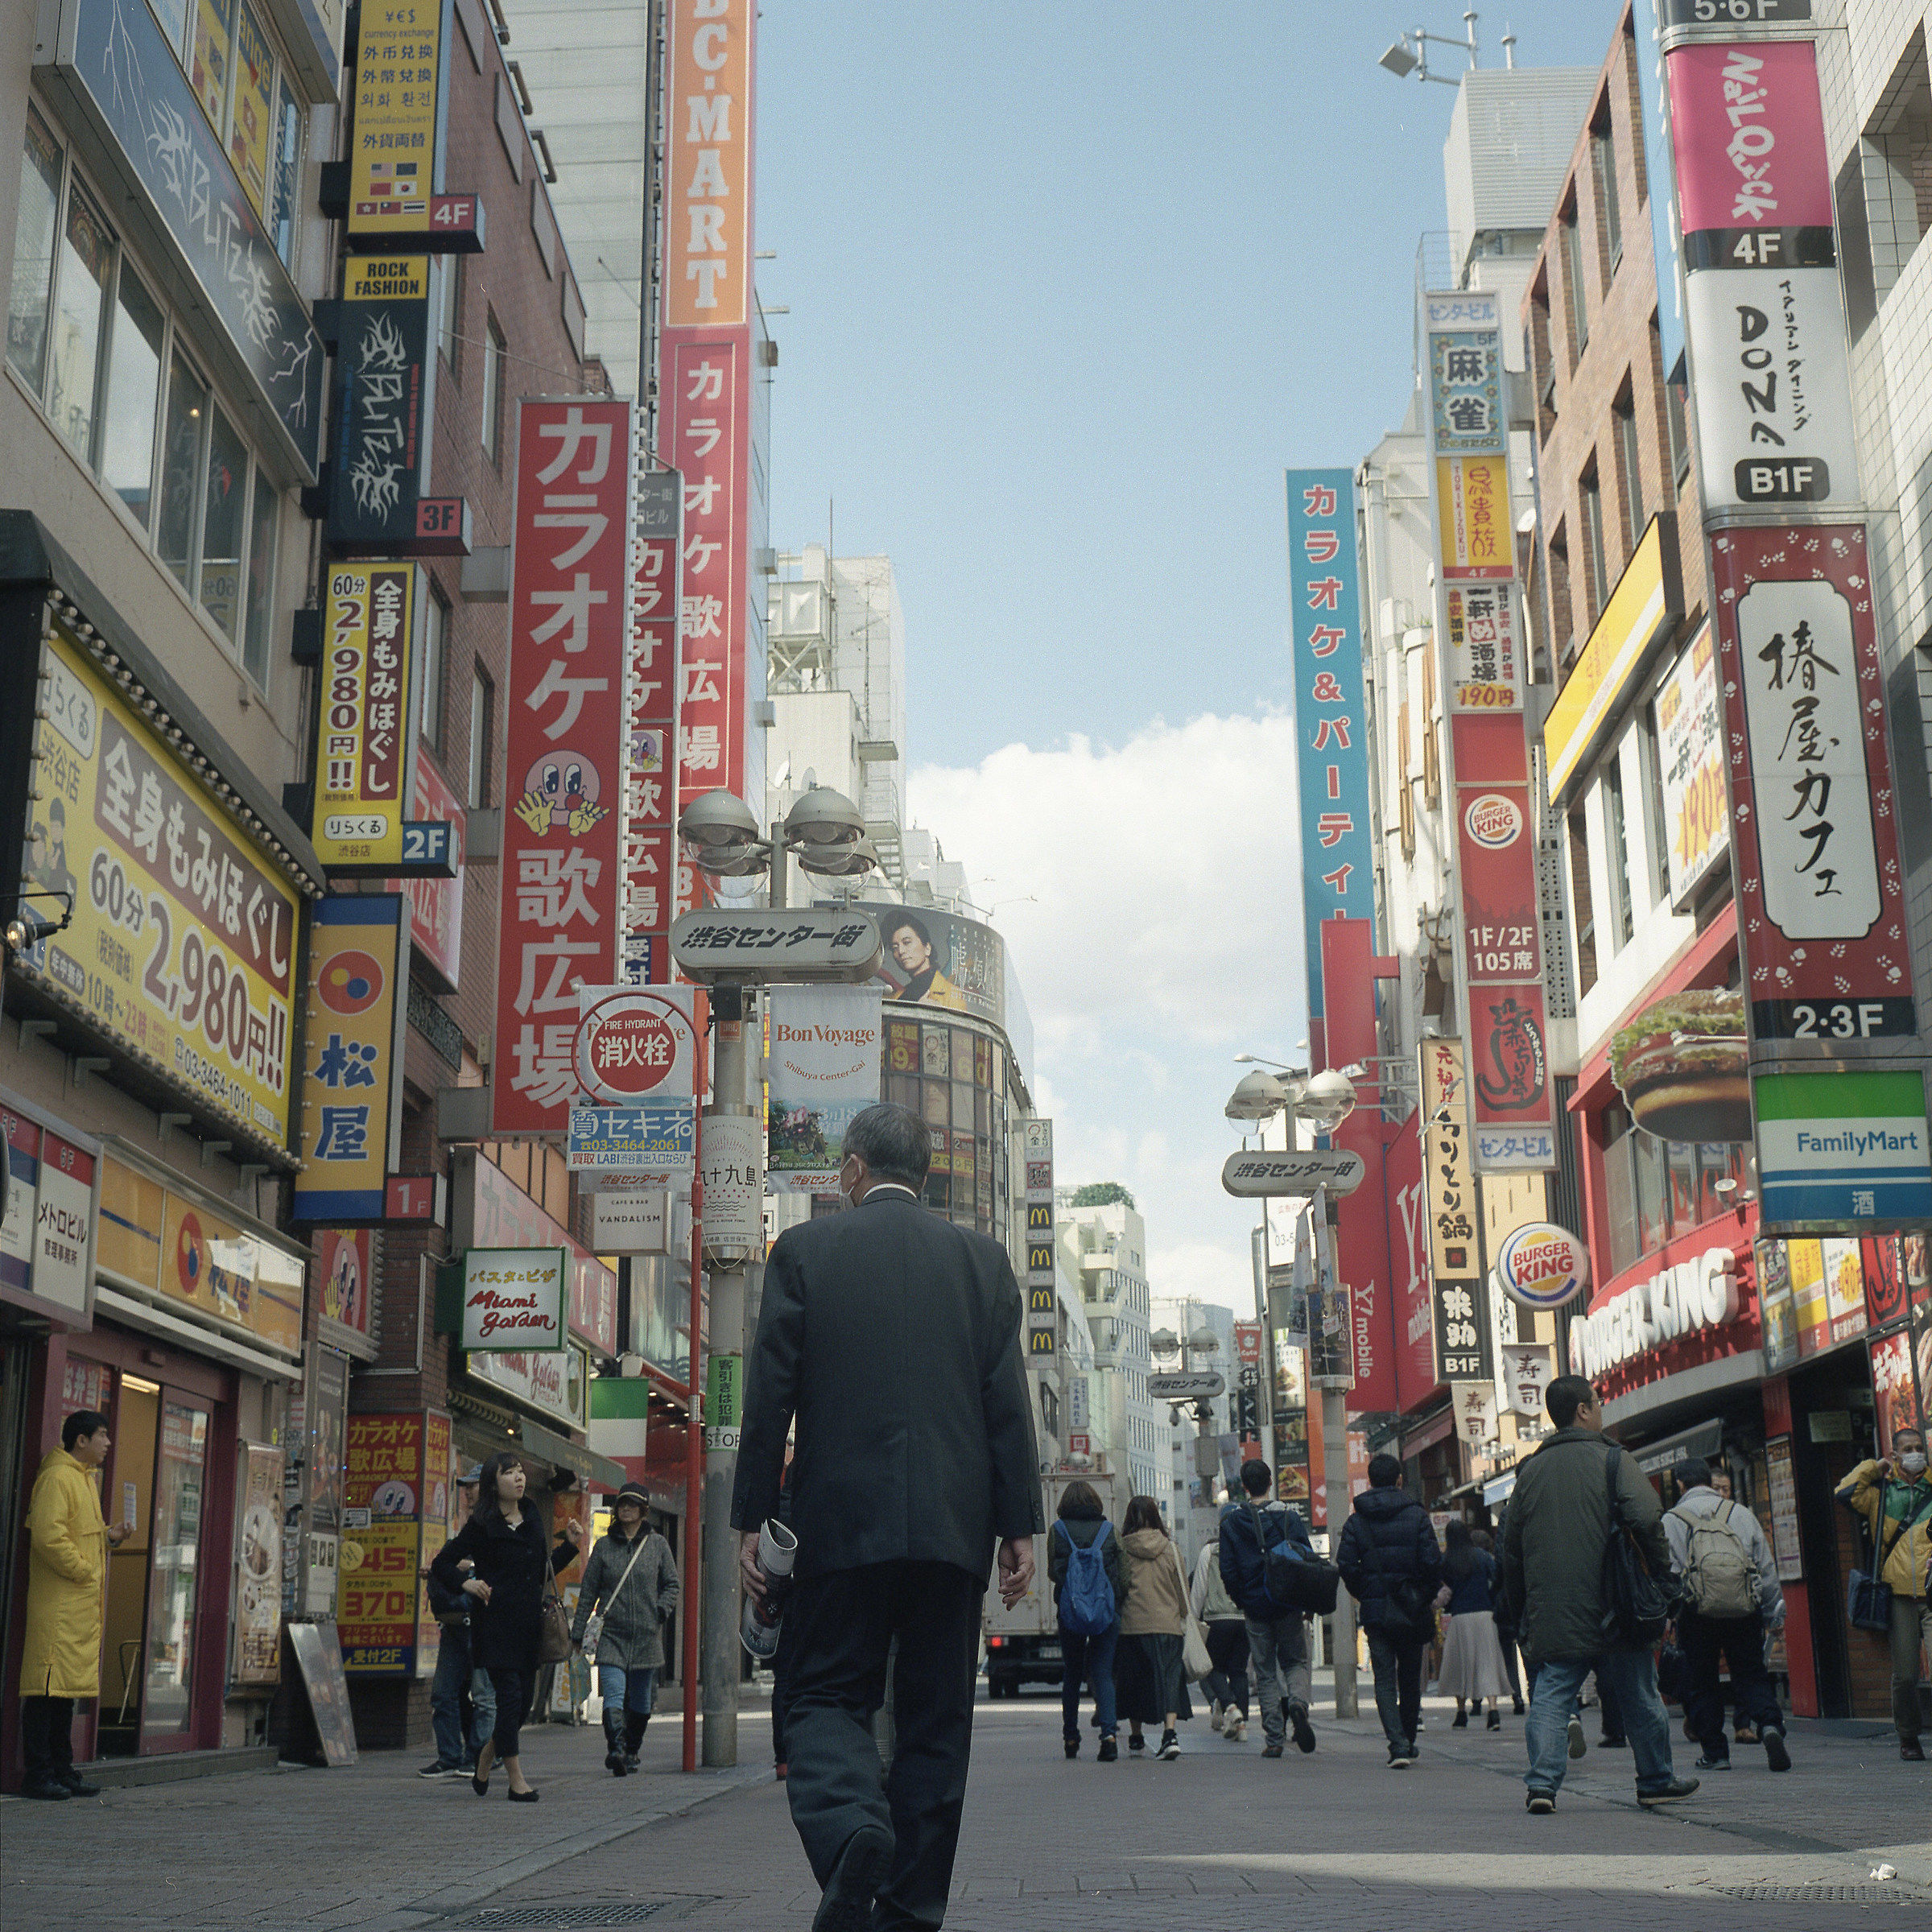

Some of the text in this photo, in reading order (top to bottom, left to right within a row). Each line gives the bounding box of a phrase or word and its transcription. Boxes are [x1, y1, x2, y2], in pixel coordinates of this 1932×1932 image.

[365, 29, 434, 39] currency exchange
[363, 132, 425, 149] 外貨両替
[434, 203, 469, 225] 4F
[1733, 233, 1781, 264] 4F
[368, 262, 409, 279] ROCK
[355, 279, 420, 295] FASHION
[1447, 349, 1486, 431] 麻雀
[1749, 467, 1813, 493] B1F
[423, 505, 454, 531] 3F
[333, 574, 366, 596] 60分
[1469, 568, 1488, 578] 4F
[368, 579, 402, 793] 全身もみほぐし
[1461, 687, 1514, 707] 190円
[1303, 485, 1355, 919] カラオケ&パーティ
[510, 407, 613, 1109] カラオケ 歌広場
[1758, 620, 1842, 897] 椿屋カフェ
[1473, 805, 1511, 824] BURGER
[1476, 815, 1514, 837] KING
[330, 820, 382, 835] りらくる
[338, 845, 371, 857] 渋谷店
[404, 828, 445, 860] 2F
[101, 737, 288, 979] 全身もみほぐし
[89, 847, 145, 935] 60分
[680, 924, 867, 948] 渋谷センター街
[1473, 951, 1534, 972] 105席
[605, 1018, 662, 1030] FIRE HYDRANT
[777, 1023, 876, 1046] Bon Voyage
[598, 1033, 671, 1069] 消火栓
[783, 1059, 867, 1081] Shibuya Center-Gai
[184, 1049, 253, 1119] 03-3464-1011
[314, 1034, 378, 1162] 松屋
[602, 1111, 692, 1139] セキネ
[591, 1140, 681, 1151] 03-3464-2061
[1479, 1135, 1552, 1158] センタービル
[1797, 1130, 1919, 1157] FamilyMart
[572, 1152, 595, 1165] 買取
[1233, 1161, 1357, 1179] 渋谷センター街
[601, 1173, 671, 1185] 渋谷センター街
[398, 1183, 428, 1216] 1F
[1852, 1191, 1876, 1216] 酒
[39, 1201, 88, 1245] メトロビル
[599, 1215, 661, 1223] VANDALISM
[1513, 1241, 1571, 1268] BURGER
[1515, 1252, 1574, 1286] KING
[467, 1290, 538, 1309] Miami
[1444, 1357, 1480, 1373] B1F
[1517, 1353, 1542, 1407] 寿司
[1463, 1390, 1487, 1438] 寿司
[349, 1420, 419, 1445] カラオケ
[349, 1446, 418, 1472] 歌広場
[345, 1591, 406, 1617] 370
[353, 1649, 402, 1663] 受付2F
